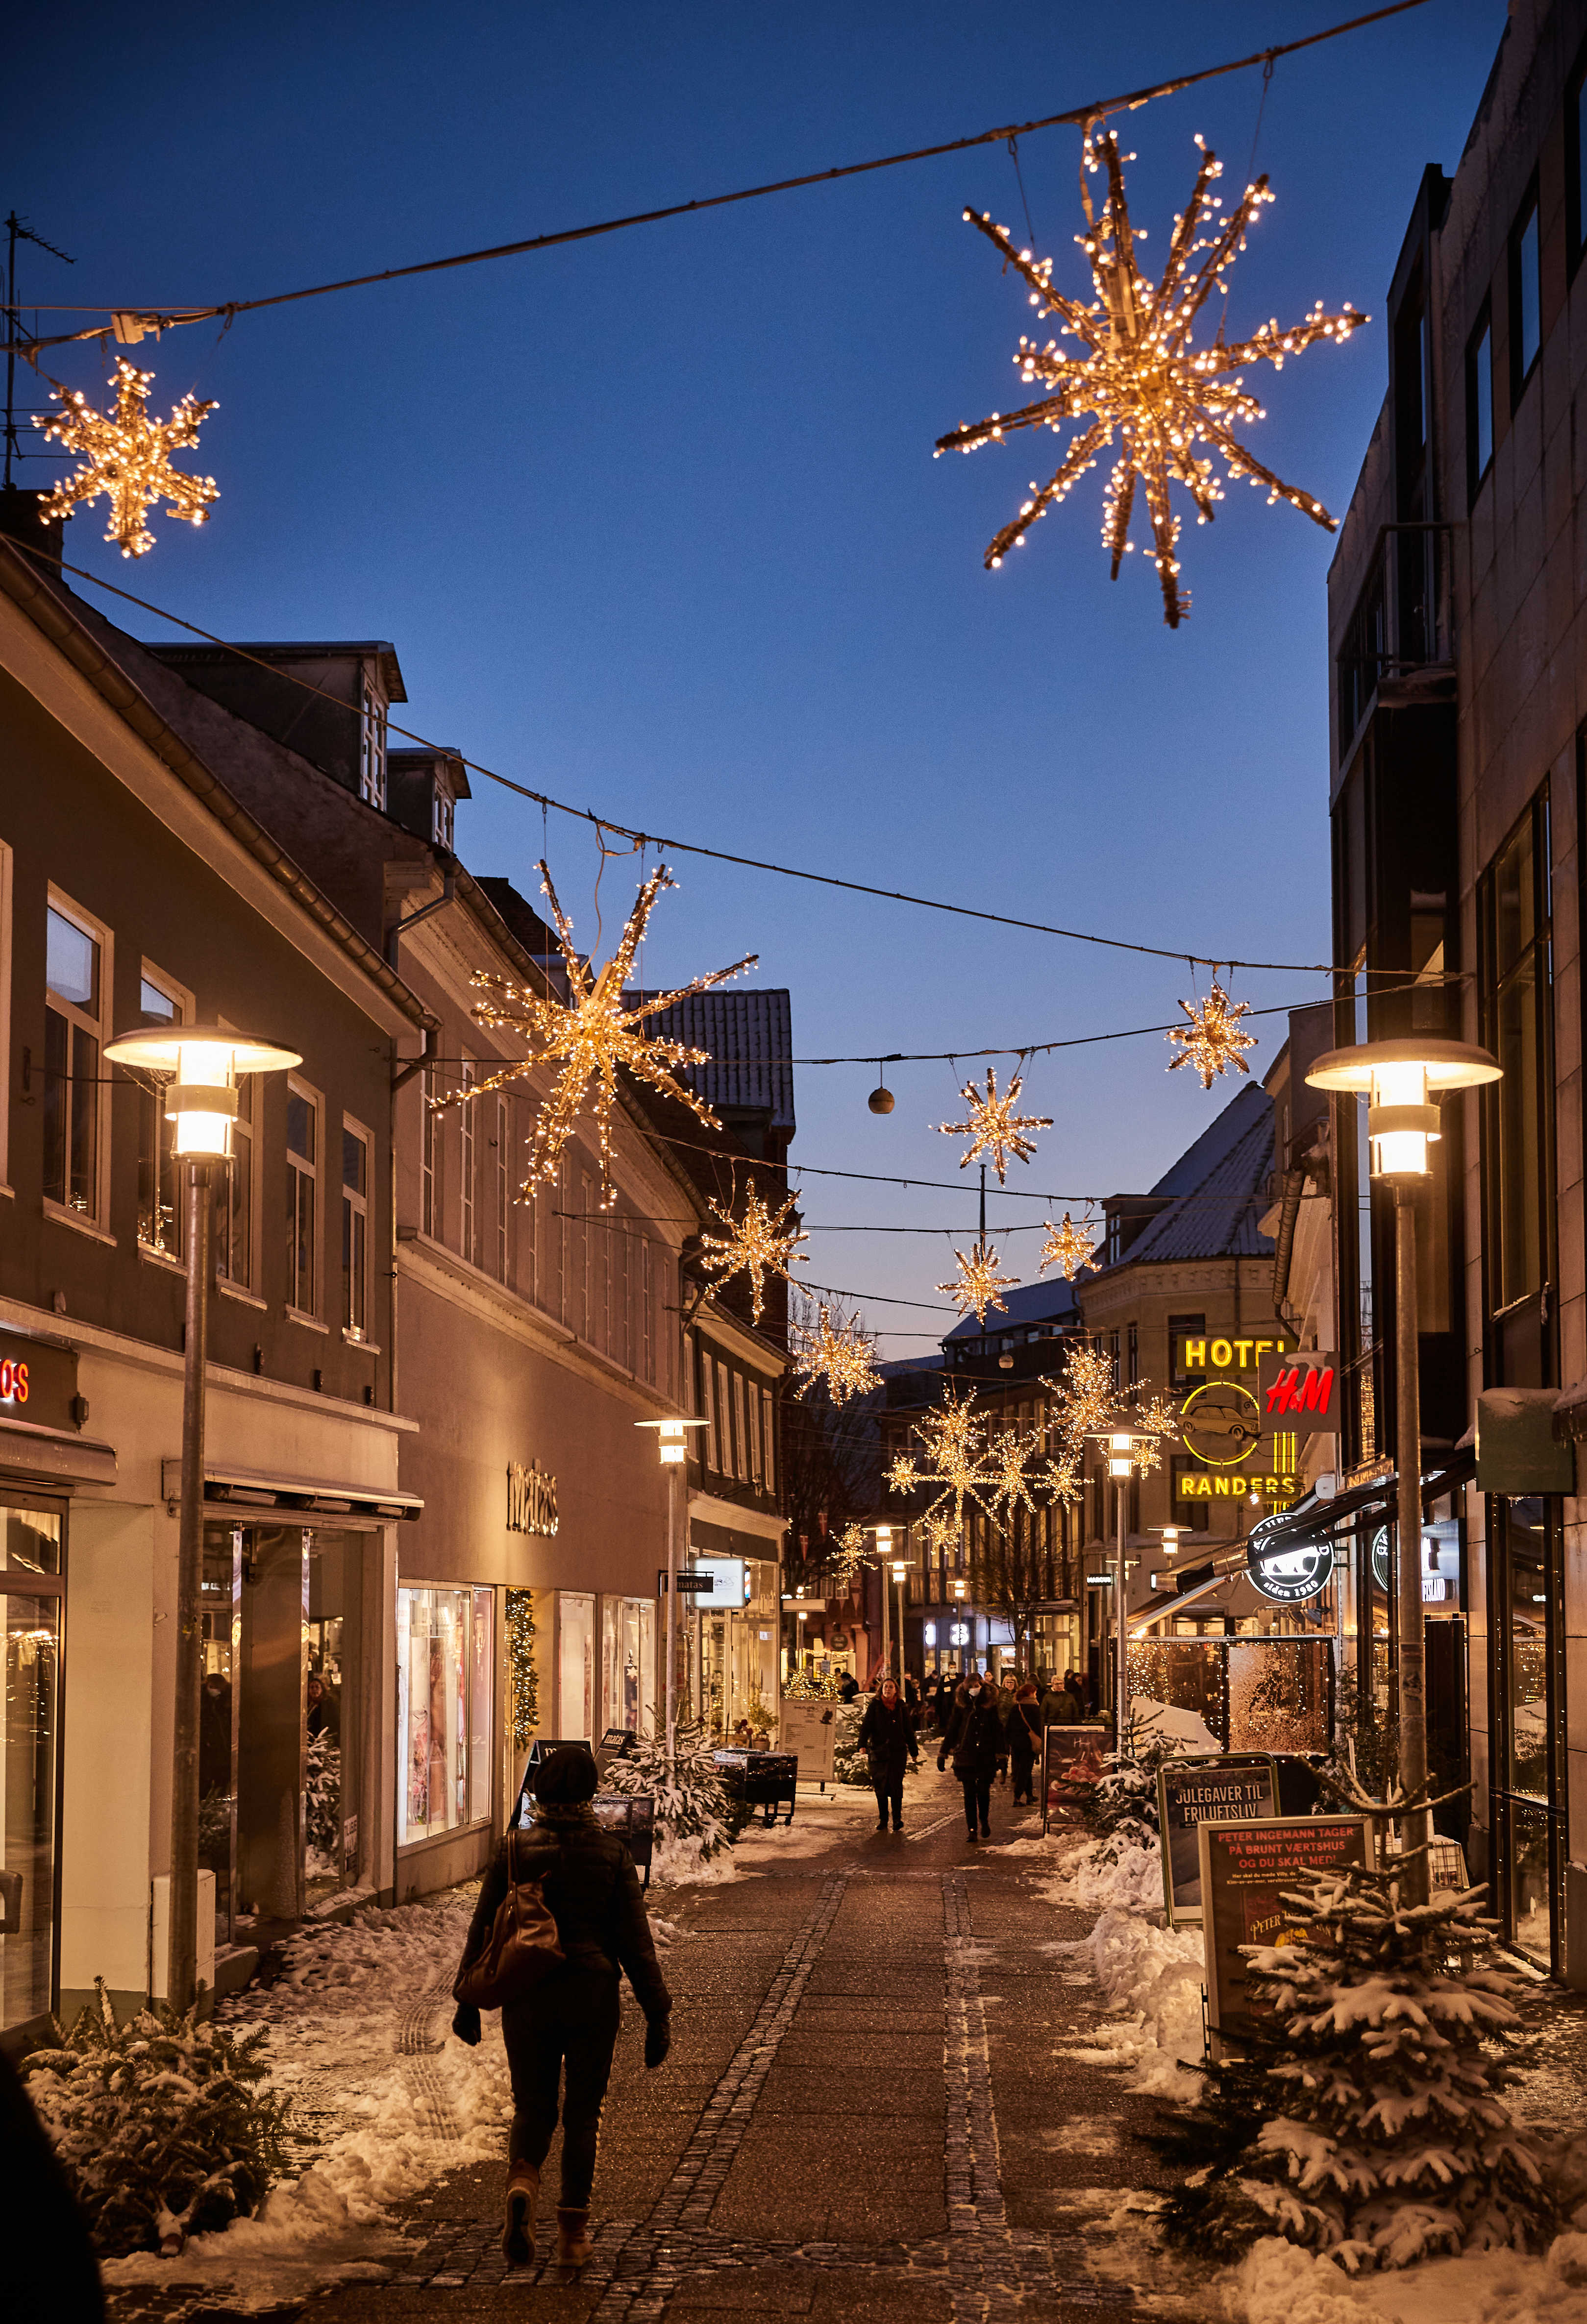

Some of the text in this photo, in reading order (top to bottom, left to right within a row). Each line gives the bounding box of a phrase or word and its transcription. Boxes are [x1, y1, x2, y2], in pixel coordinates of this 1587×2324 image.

[1182, 1476, 1295, 1495] RANDERS
[1263, 1580, 1318, 1597] siden 1980
[605, 1734, 625, 1746] matas
[1175, 1785, 1264, 1804] JULEGAVER TIL
[1184, 1803, 1257, 1822] FRILUFTSLIV
[1218, 1827, 1354, 1842] PETER INGEMANN TAGER
[1229, 1841, 1346, 1856] PÅ BRUNT VÆRTSHUS
[1239, 1859, 1256, 1869] OG
[1259, 1858, 1274, 1868] DU
[1277, 1857, 1306, 1867] SKAL
[1250, 1915, 1281, 1942] PETER
